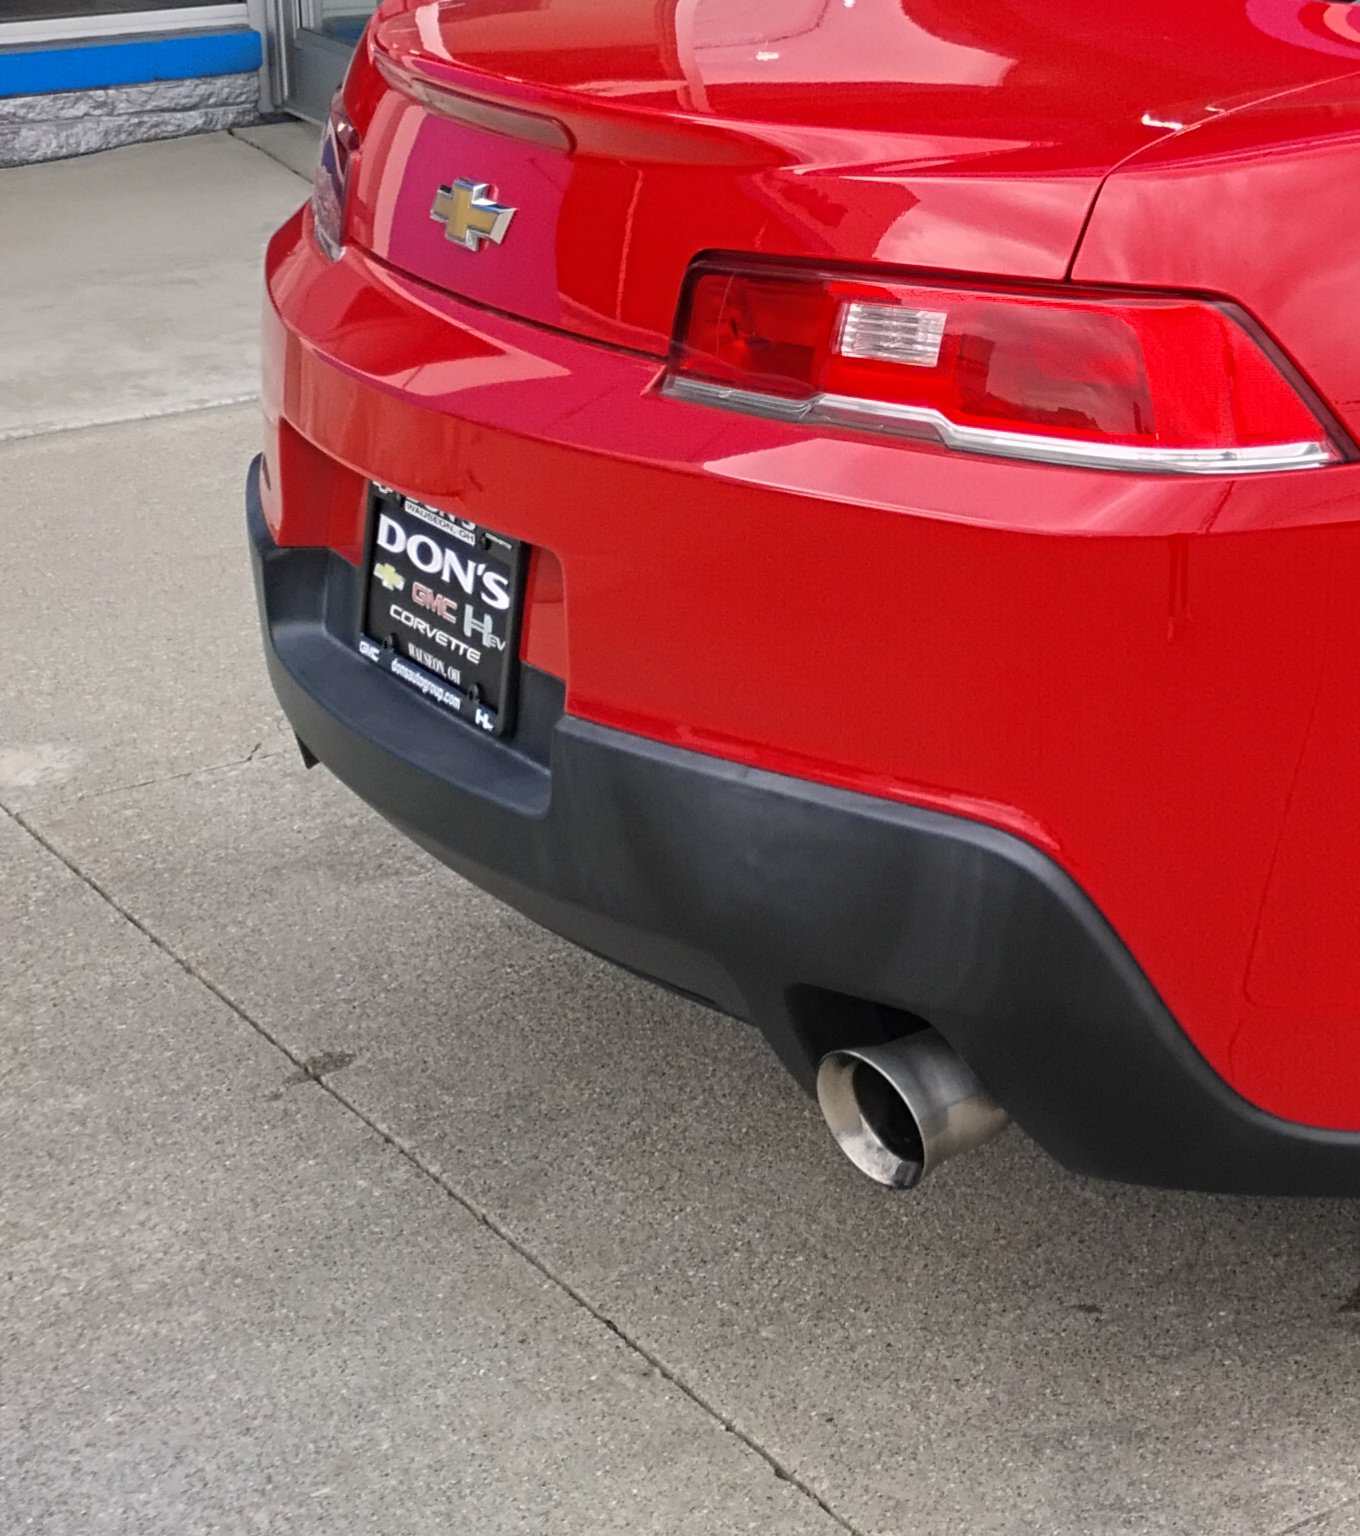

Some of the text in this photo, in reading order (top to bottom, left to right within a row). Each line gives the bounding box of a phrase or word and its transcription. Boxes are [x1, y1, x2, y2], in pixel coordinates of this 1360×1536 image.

[377, 513, 511, 610] DON'S
[411, 581, 458, 624] GMC
[390, 604, 481, 664] CORVETTE
